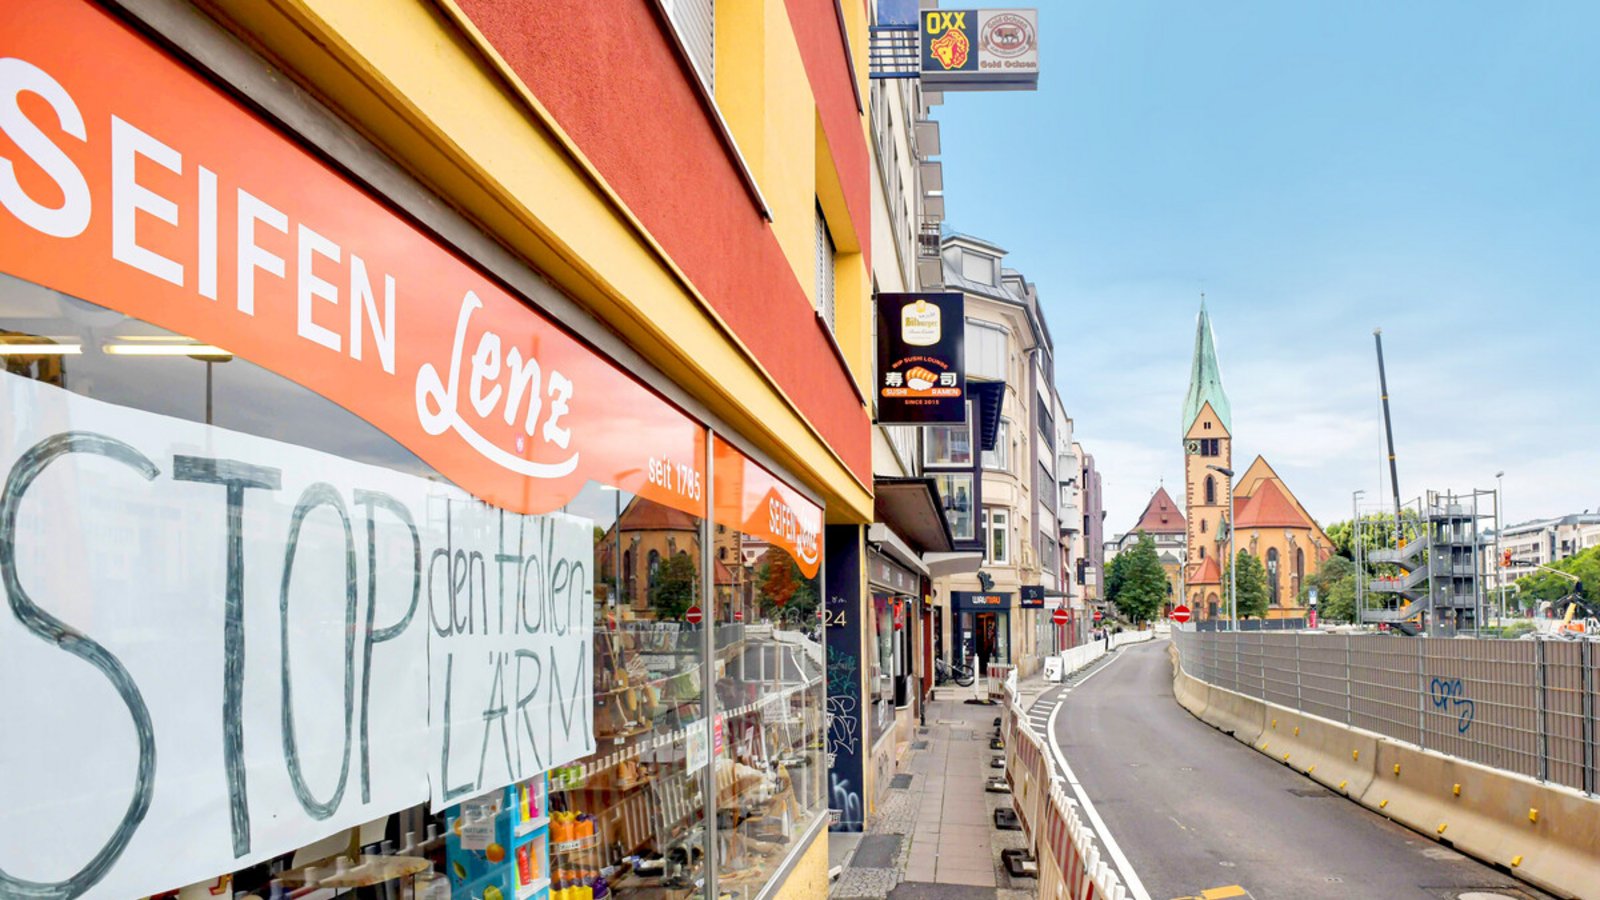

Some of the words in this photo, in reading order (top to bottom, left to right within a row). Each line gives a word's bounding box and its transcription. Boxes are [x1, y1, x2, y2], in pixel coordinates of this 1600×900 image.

[926, 12, 966, 34] OXX
[0, 57, 396, 376] SEIFEN
[415, 290, 580, 479] Lenz
[940, 372, 957, 388] 司
[648, 453, 672, 491] seit
[676, 463, 701, 501] 1785
[768, 497, 796, 543] SEIFEN
[428, 498, 487, 637] den
[0, 431, 421, 900] STOP
[442, 640, 591, 803] LÄRM
